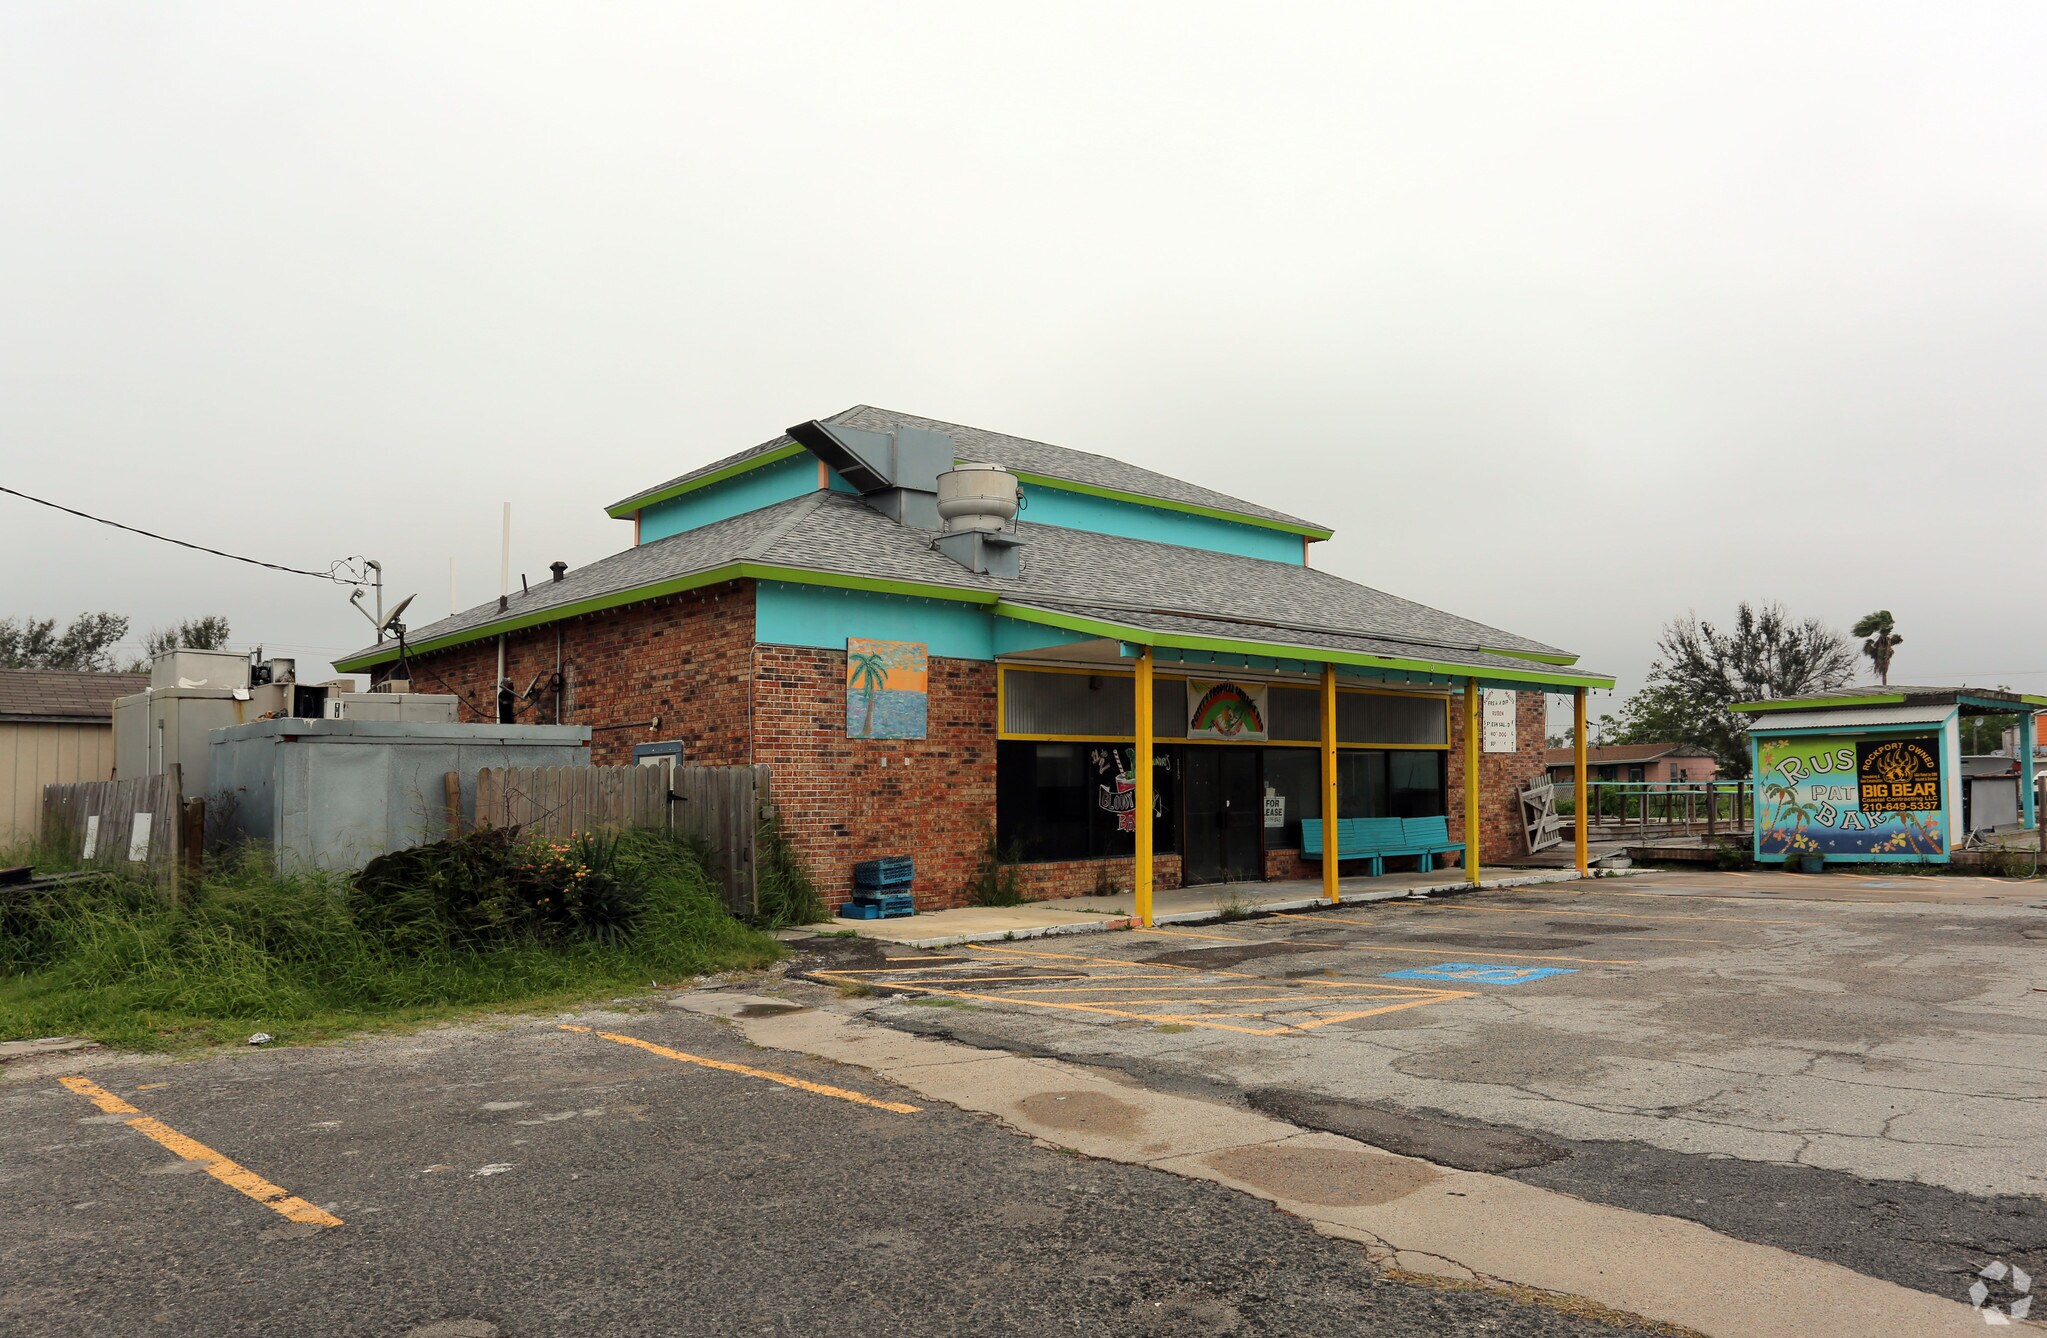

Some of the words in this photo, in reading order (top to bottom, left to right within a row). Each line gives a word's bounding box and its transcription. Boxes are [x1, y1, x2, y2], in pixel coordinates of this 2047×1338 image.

[1862, 742, 1903, 771] ROCKPORT
[1908, 744, 1935, 768] OWNED
[1862, 784, 1888, 798] BIG
[1892, 782, 1936, 797] BEAR
[1265, 800, 1280, 808] FOR
[1862, 801, 1938, 811] 210-649-5337
[1264, 808, 1283, 817] EASE
[1814, 801, 1887, 831] BAR
[1116, 813, 1136, 832] BA
